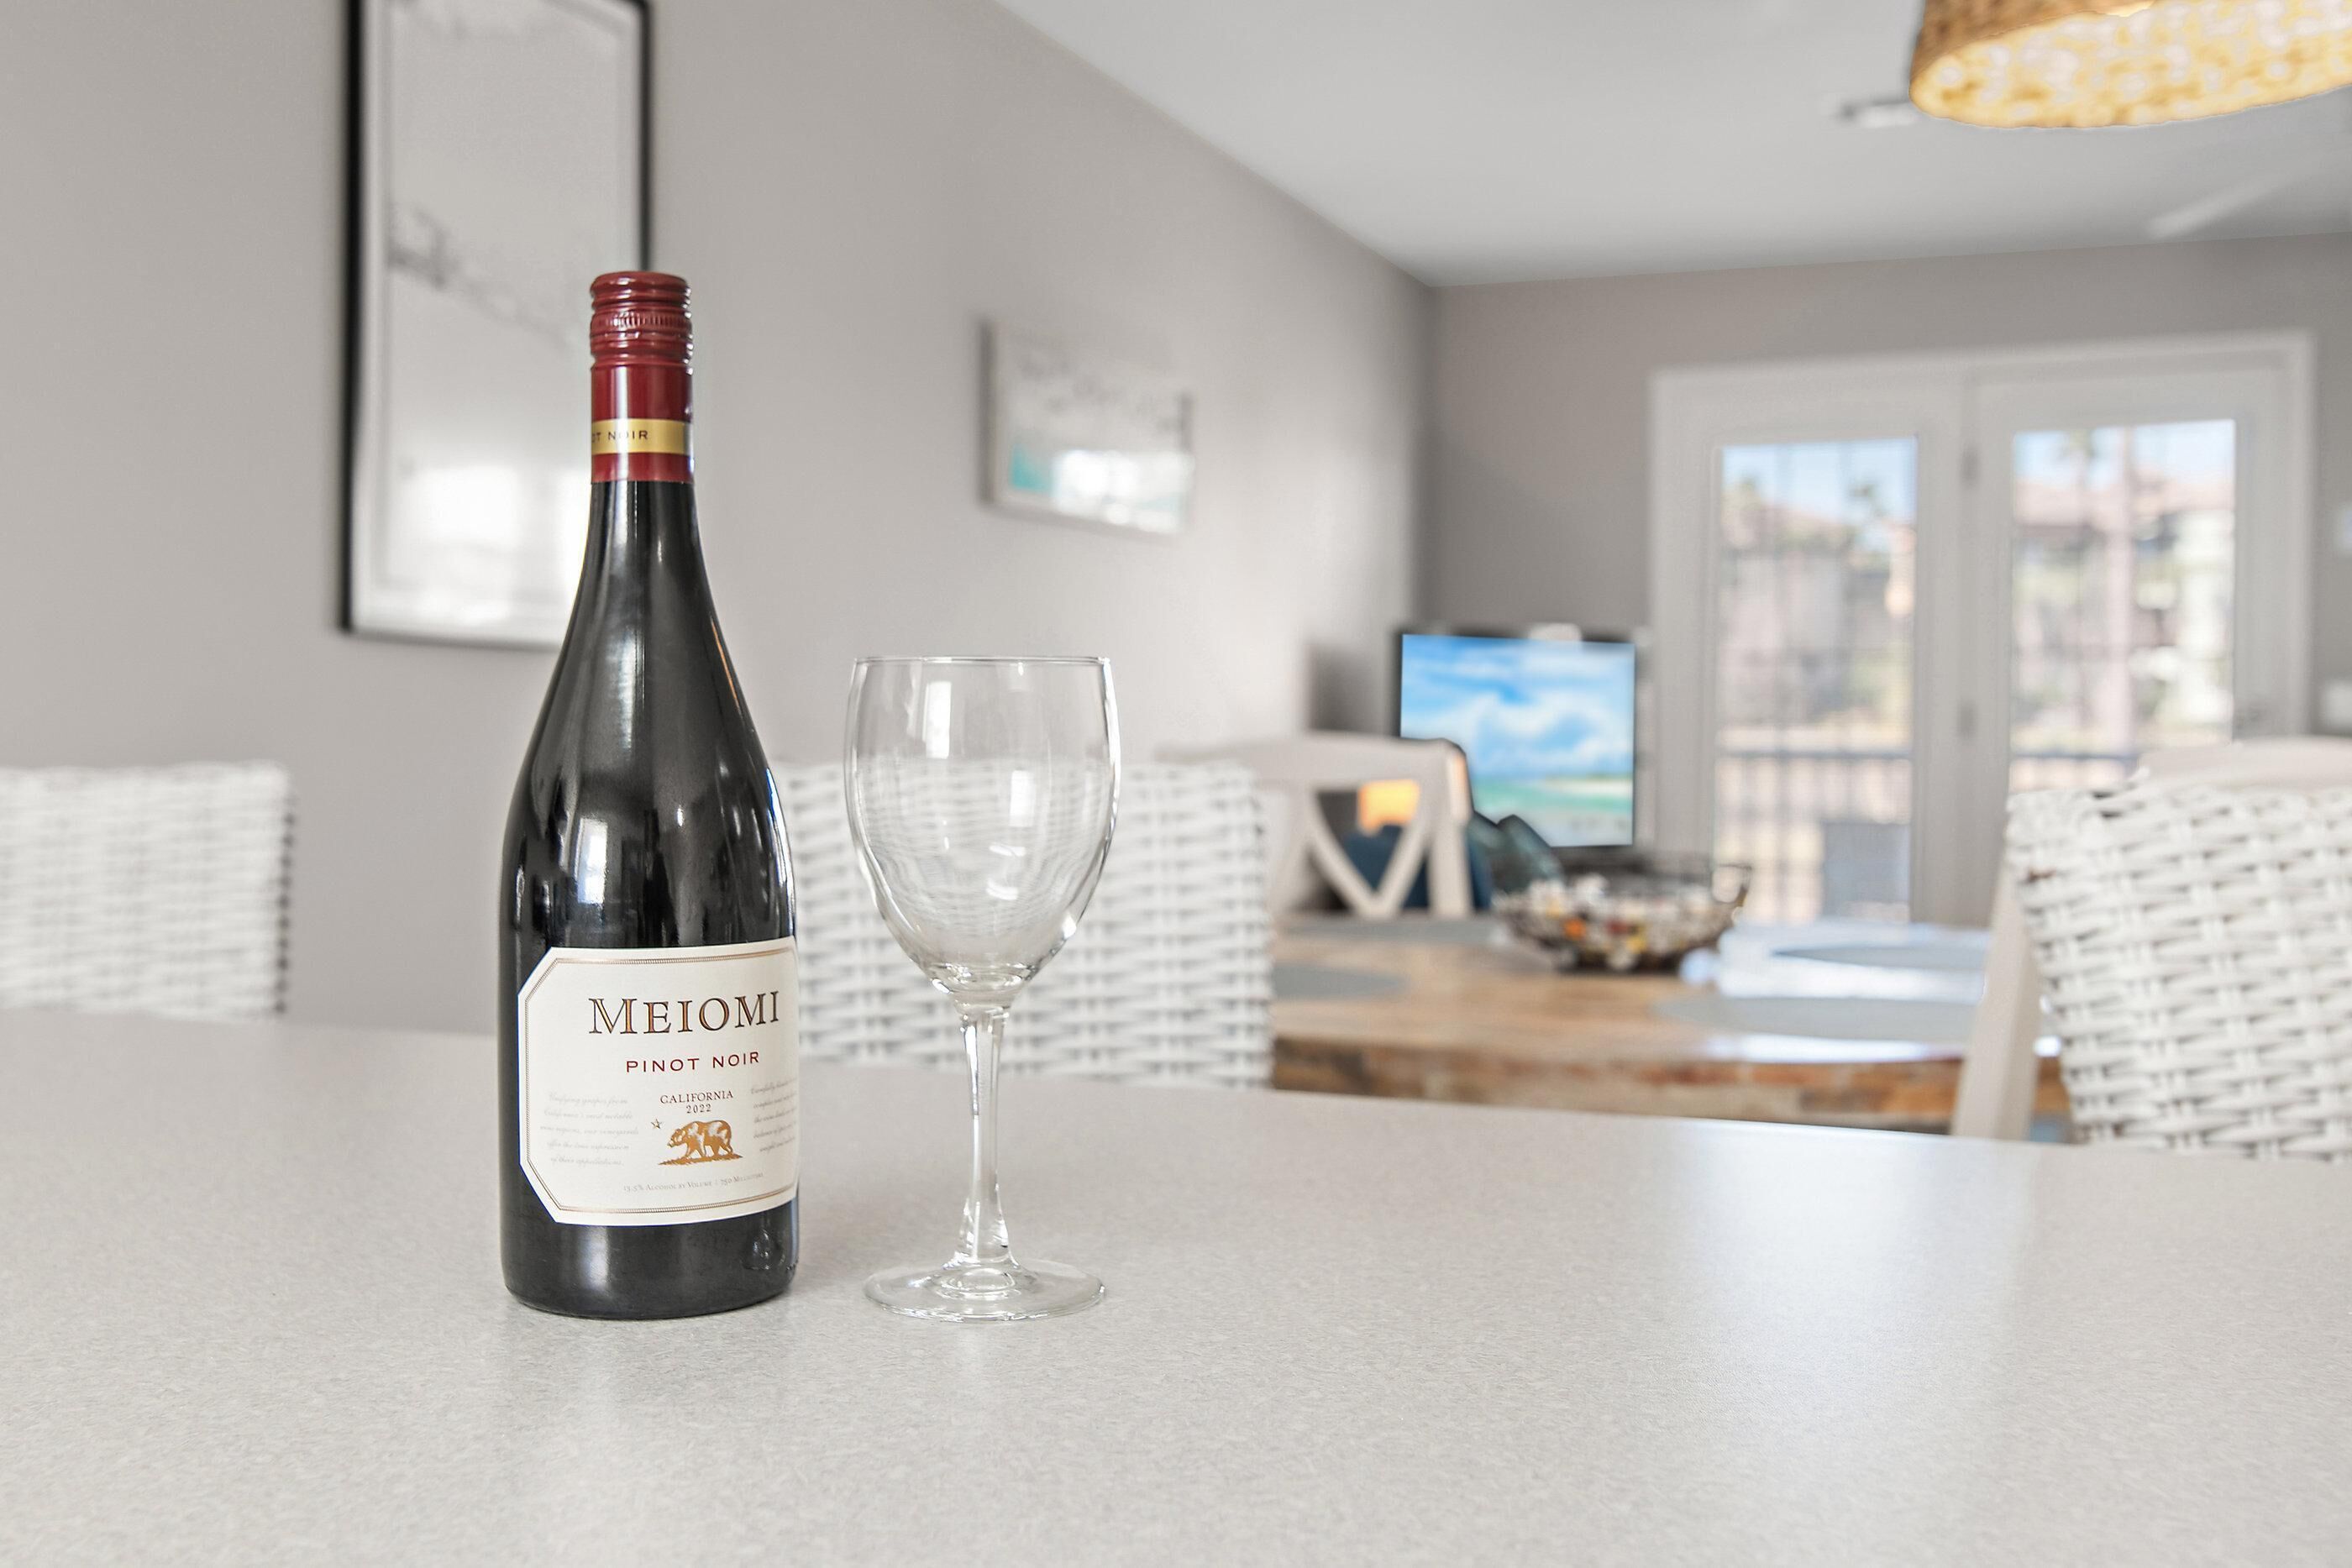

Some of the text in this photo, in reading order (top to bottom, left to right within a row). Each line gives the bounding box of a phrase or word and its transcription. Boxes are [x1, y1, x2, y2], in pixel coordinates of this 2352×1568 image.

[588, 991, 779, 1034] MEIOMI
[627, 1051, 759, 1072] PINOT NOIR
[660, 1090, 733, 1104] CALIFORNIA
[685, 1104, 712, 1114] 2022
